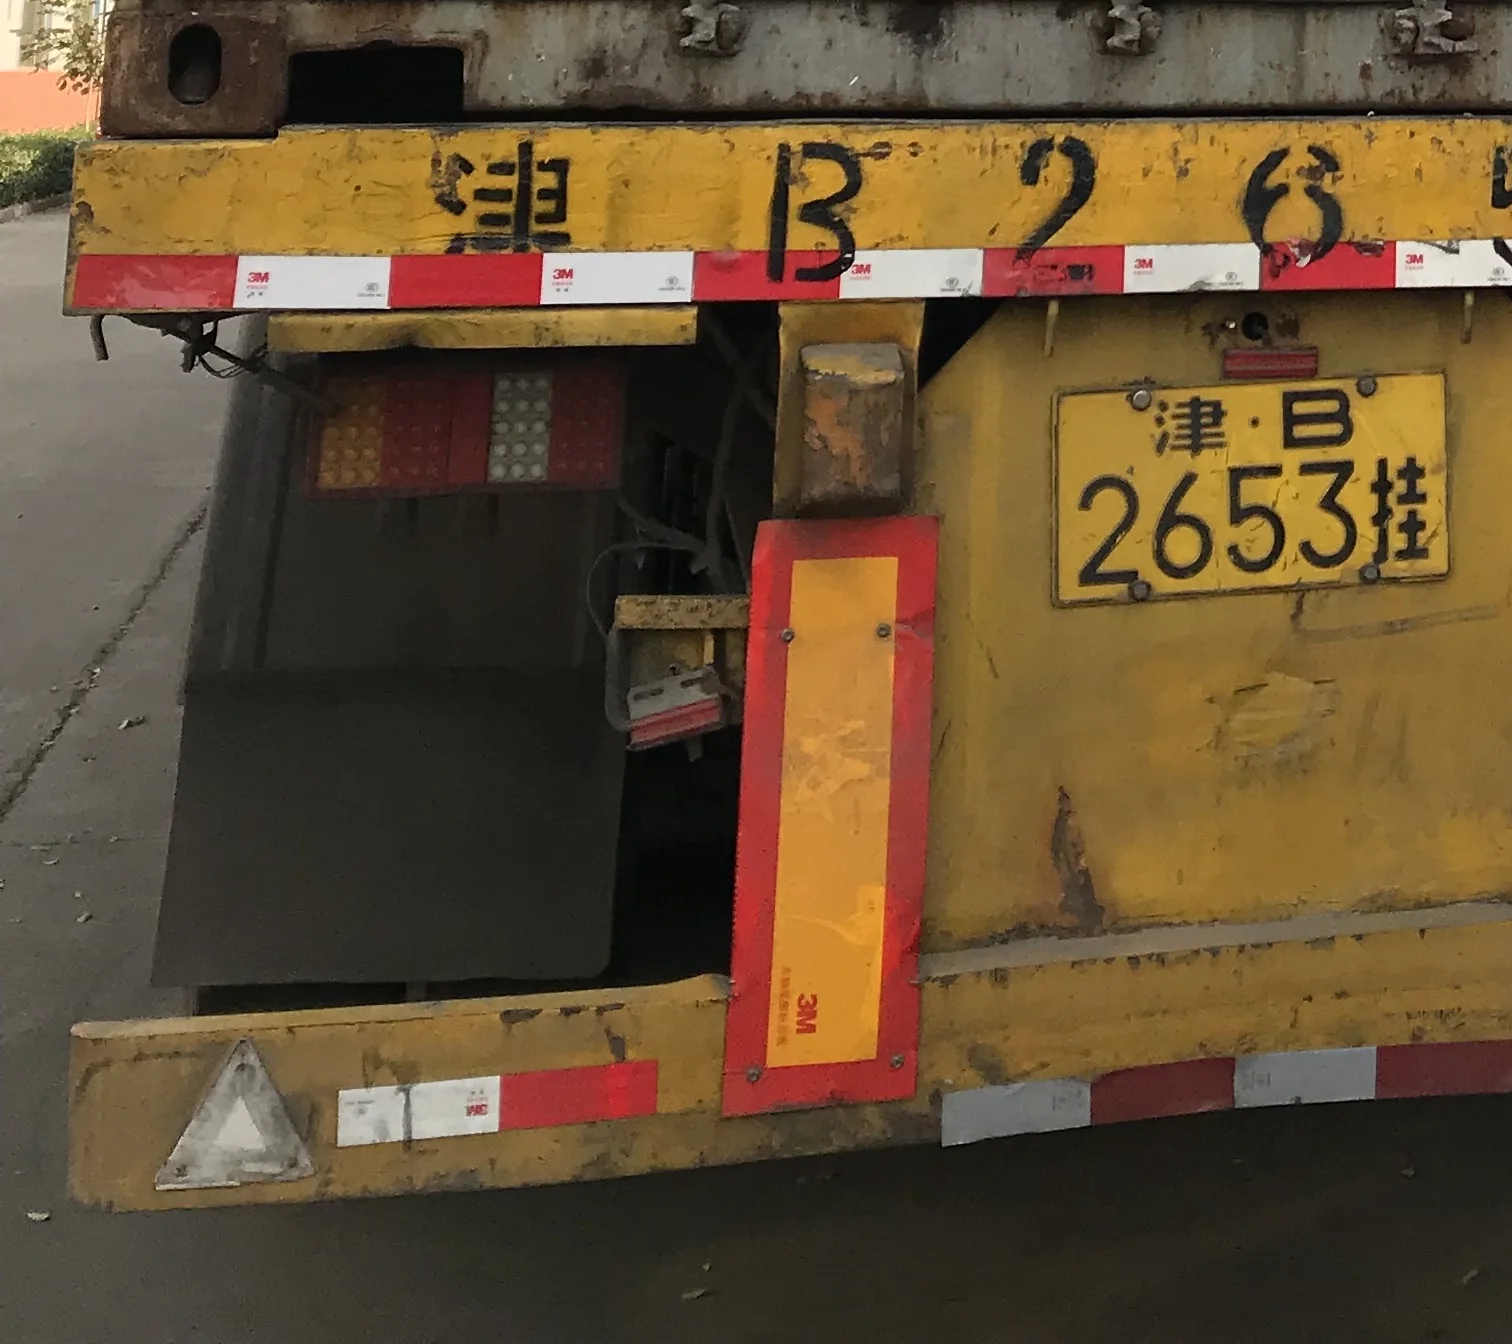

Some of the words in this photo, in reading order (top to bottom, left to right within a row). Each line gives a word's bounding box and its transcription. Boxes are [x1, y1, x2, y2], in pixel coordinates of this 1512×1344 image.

[1133, 257, 1154, 271] 3M
[1404, 253, 1425, 266] 3M
[247, 271, 270, 285] 3M
[552, 267, 574, 281] 3M
[1077, 455, 1430, 588] 2653挂
